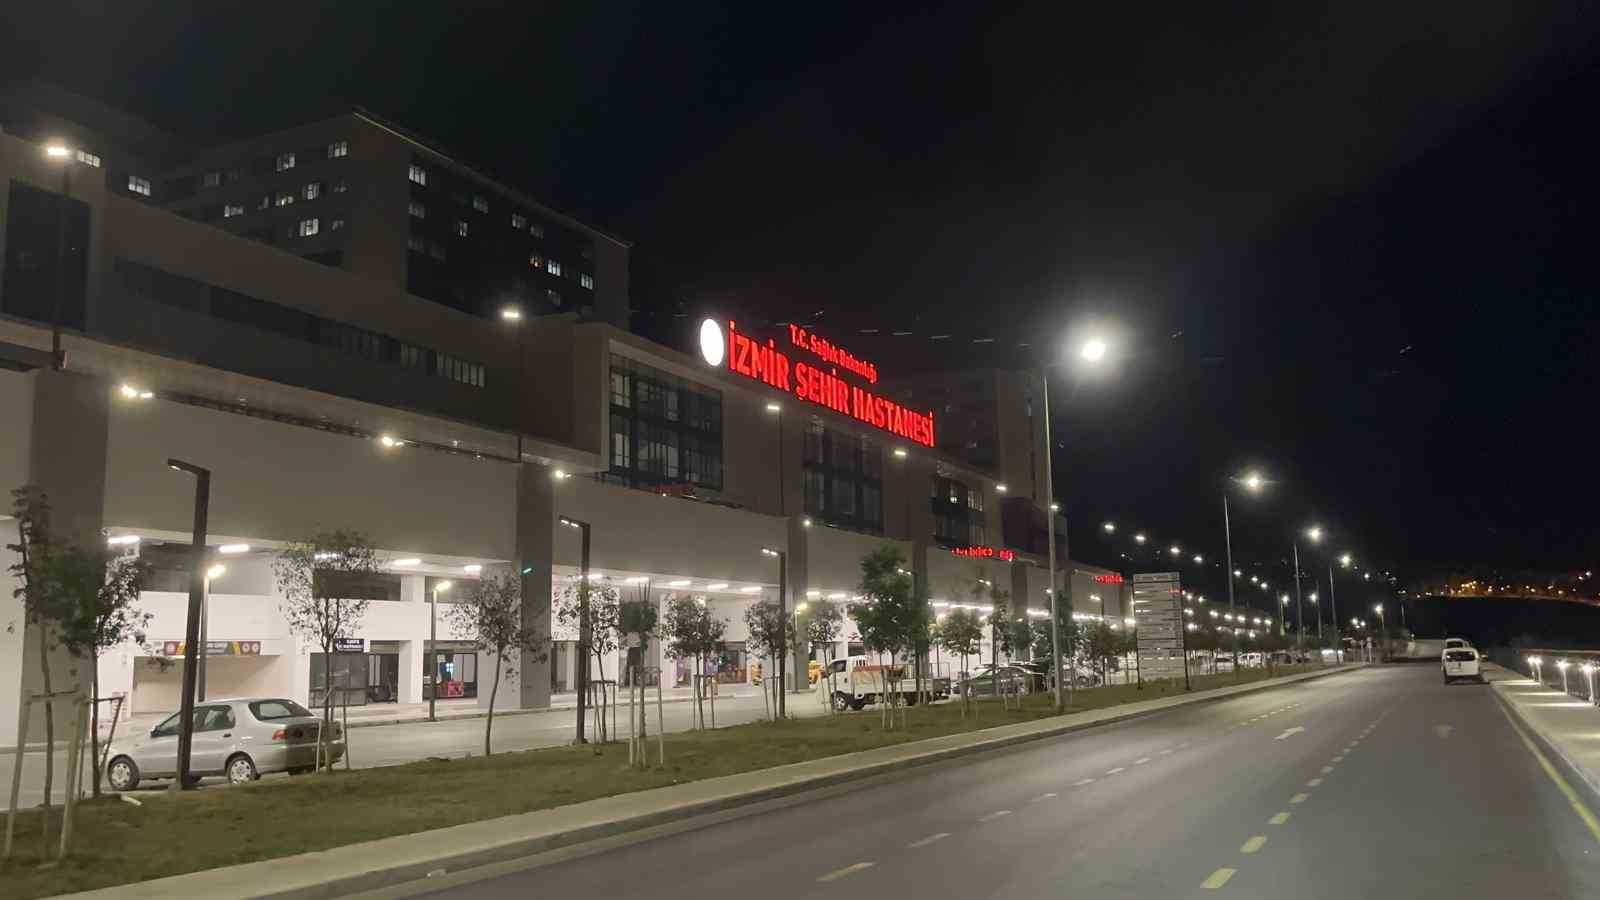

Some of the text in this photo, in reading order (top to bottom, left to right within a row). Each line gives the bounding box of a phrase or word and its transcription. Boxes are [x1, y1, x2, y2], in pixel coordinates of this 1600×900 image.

[790, 323, 809, 350] T.C.
[728, 320, 935, 447] İZMİR ŞEHİR HASTANESİ
